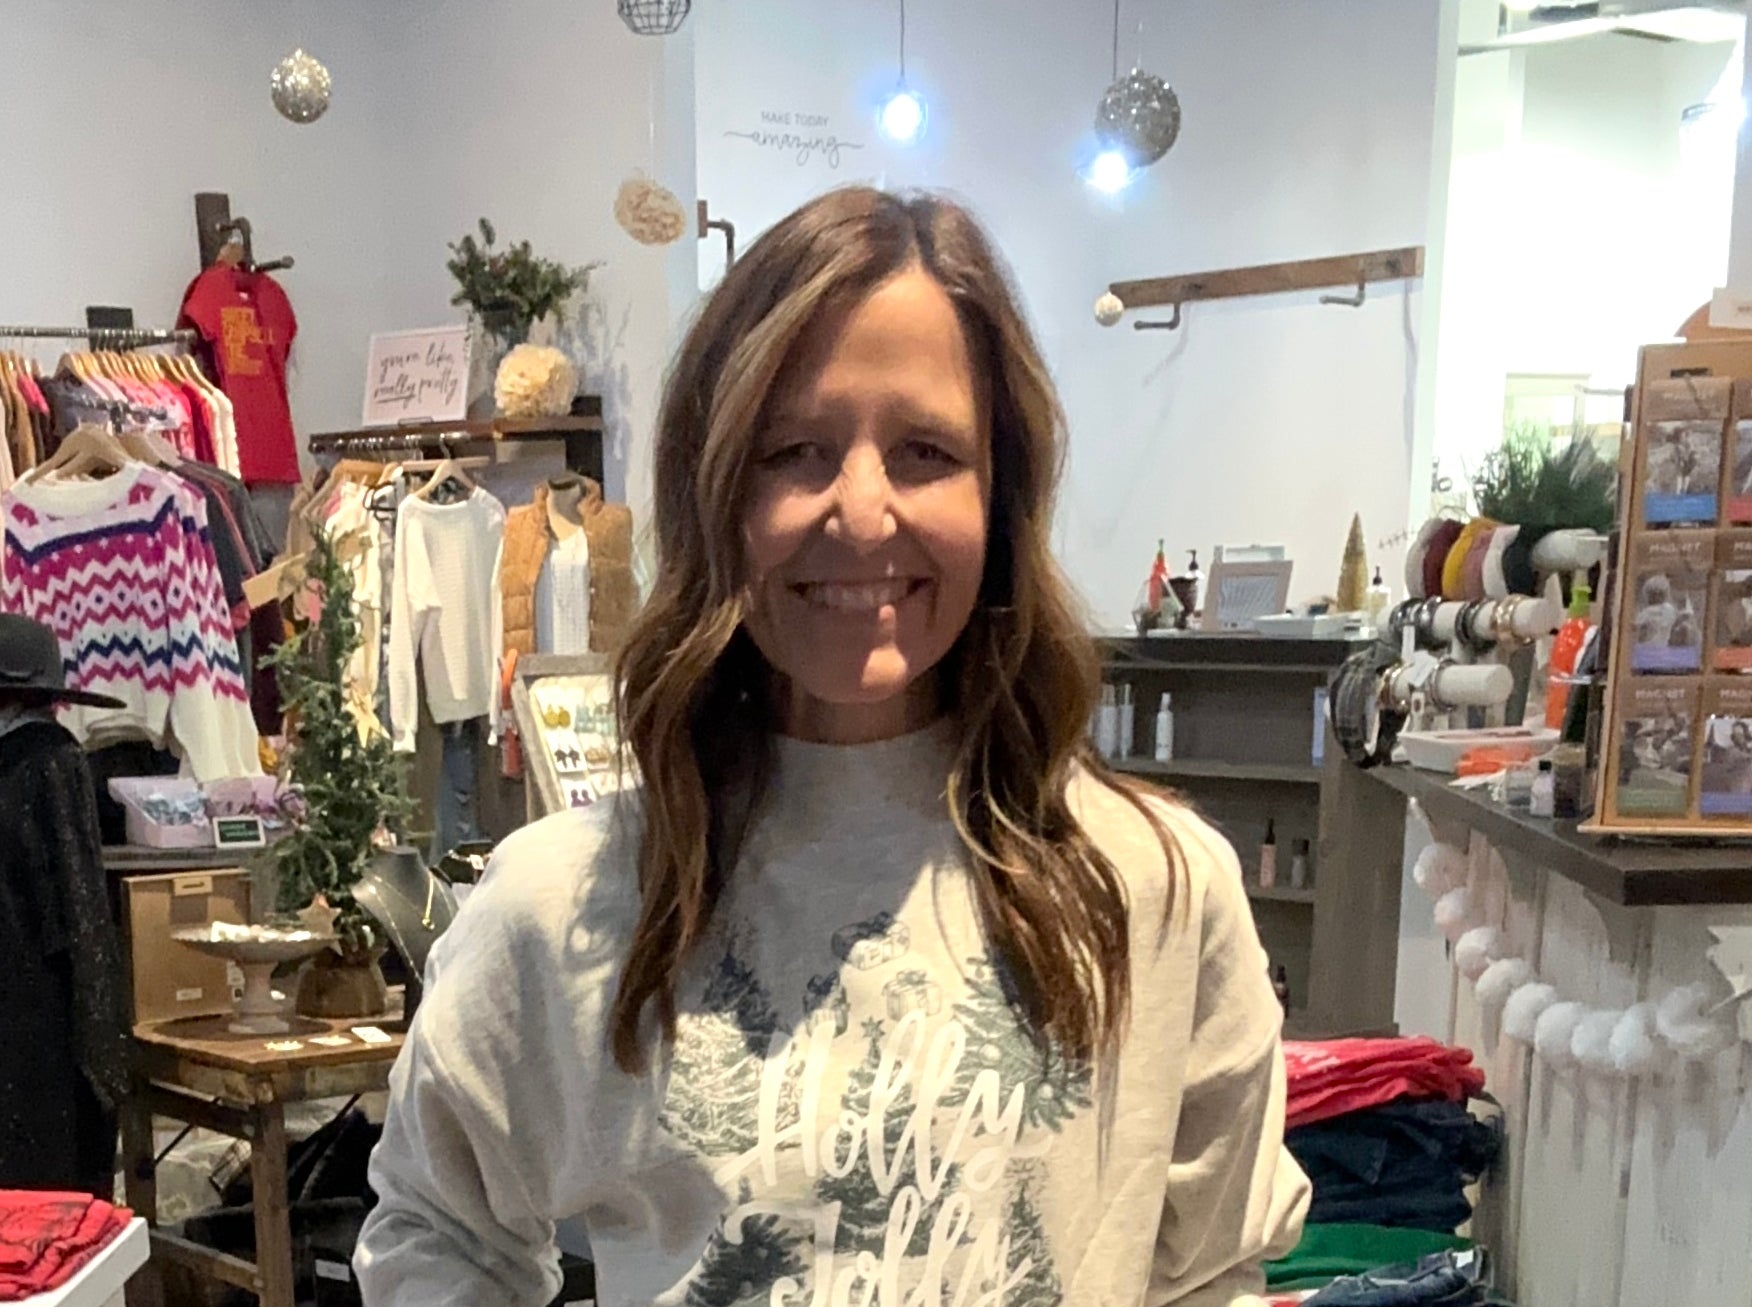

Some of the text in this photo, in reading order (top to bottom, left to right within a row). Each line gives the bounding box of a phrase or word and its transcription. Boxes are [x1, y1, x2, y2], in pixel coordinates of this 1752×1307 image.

[761, 111, 829, 127] MAKE TODAY
[723, 130, 864, 169] amazing
[714, 1008, 1052, 1200] Holly
